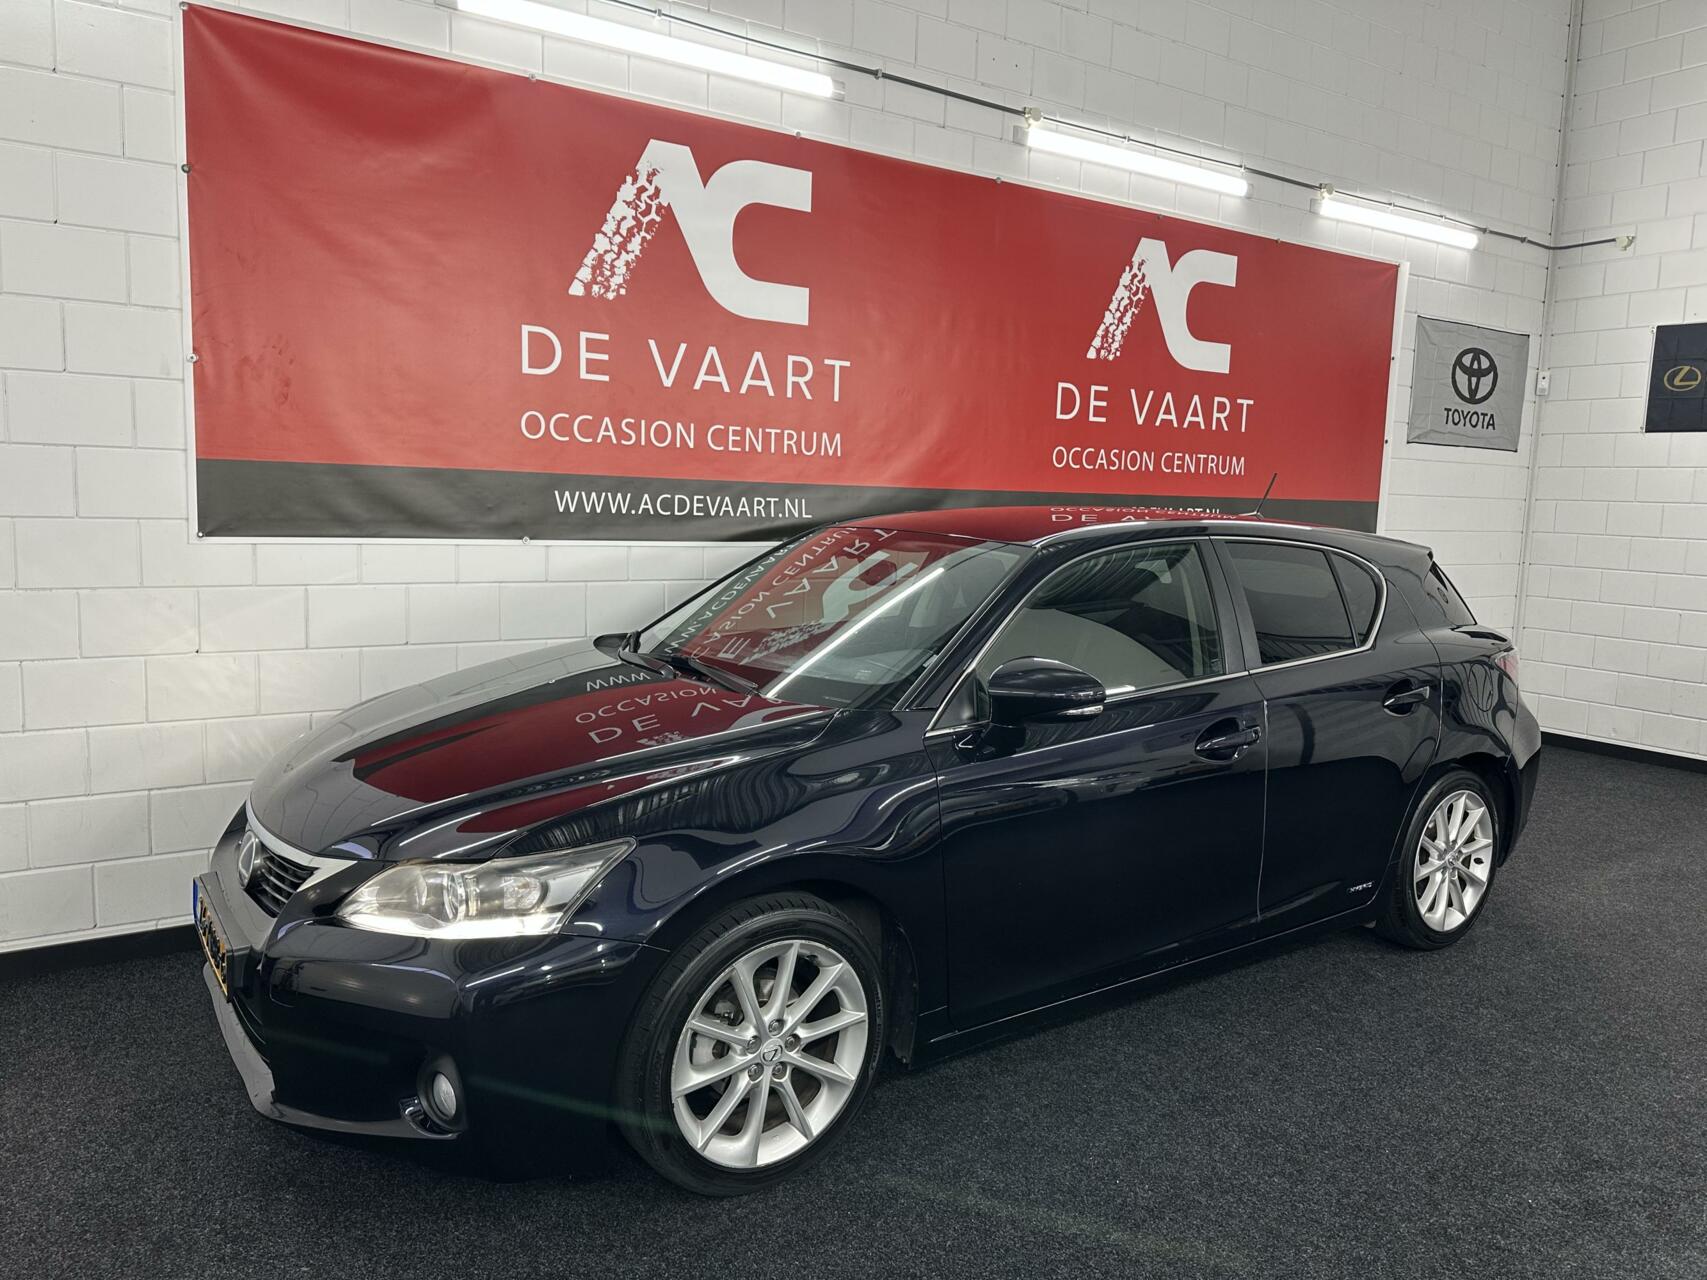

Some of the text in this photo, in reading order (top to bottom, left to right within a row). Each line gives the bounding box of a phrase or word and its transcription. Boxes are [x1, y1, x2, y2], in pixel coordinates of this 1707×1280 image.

[521, 324, 851, 402] DE VAART
[1055, 381, 1255, 433] DE VAART
[1444, 407, 1496, 431] TOYOTA
[520, 410, 841, 457] OCCASION CENTRUM
[1052, 446, 1245, 476] OCCASION CENTRUM
[554, 490, 812, 519] WWW.ACDEVAART.NL
